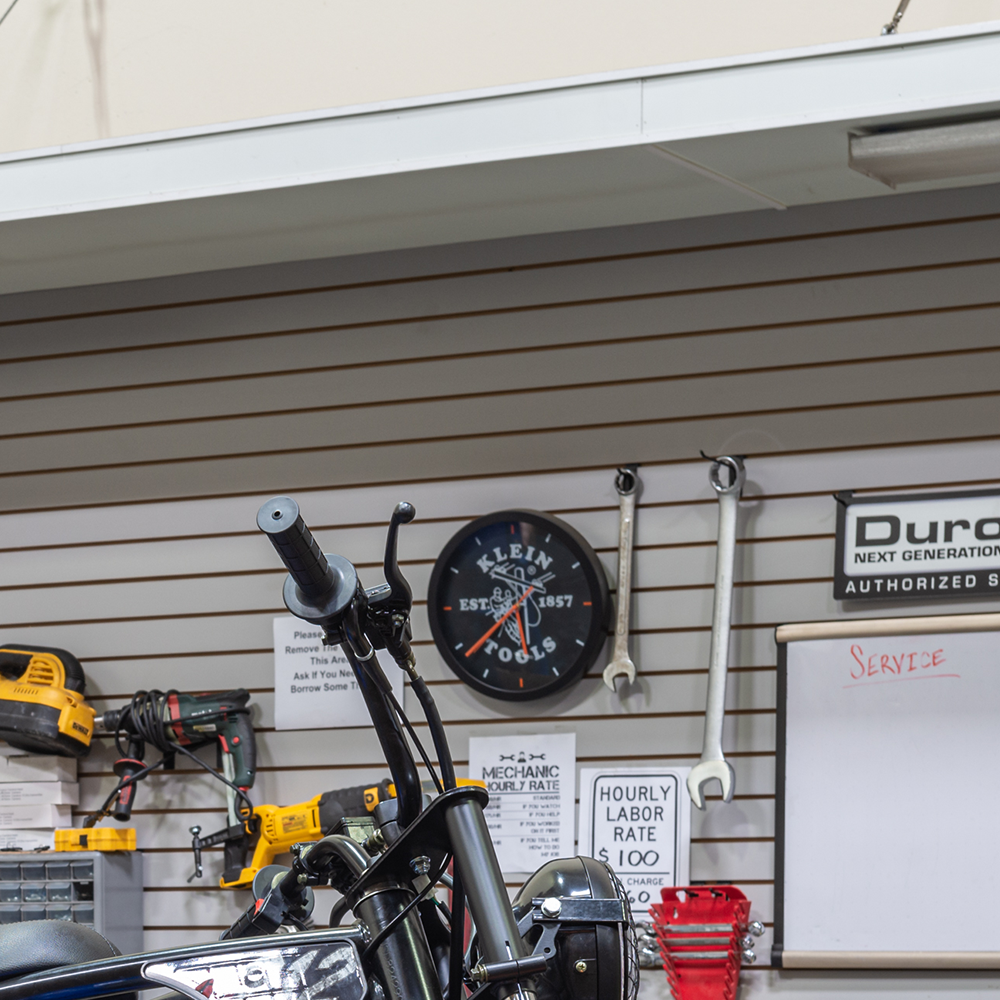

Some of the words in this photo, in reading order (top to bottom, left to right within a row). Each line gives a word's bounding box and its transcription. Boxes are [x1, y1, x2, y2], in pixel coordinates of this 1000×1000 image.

[476, 544, 553, 574] KLEIN
[854, 551, 896, 564] NEXT
[845, 574, 977, 594] AUTHORIZED
[459, 598, 490, 611] EST.
[538, 594, 573, 608] 1857
[285, 646, 319, 654] Remove
[322, 644, 338, 652] The
[484, 636, 556, 664] TOOLS
[310, 657, 328, 665] This
[850, 644, 946, 680] SERVICE
[294, 672, 310, 680] Ask
[320, 671, 337, 679] You
[290, 685, 321, 694] Borrow
[324, 682, 348, 692] Some
[482, 765, 560, 780] MECHANIC
[530, 780, 560, 791] RATE
[600, 785, 672, 802] HOURLY
[607, 806, 664, 822] LABOR
[614, 826, 656, 842] RATE
[619, 850, 659, 866] 100
[627, 878, 664, 886] CHARGE
